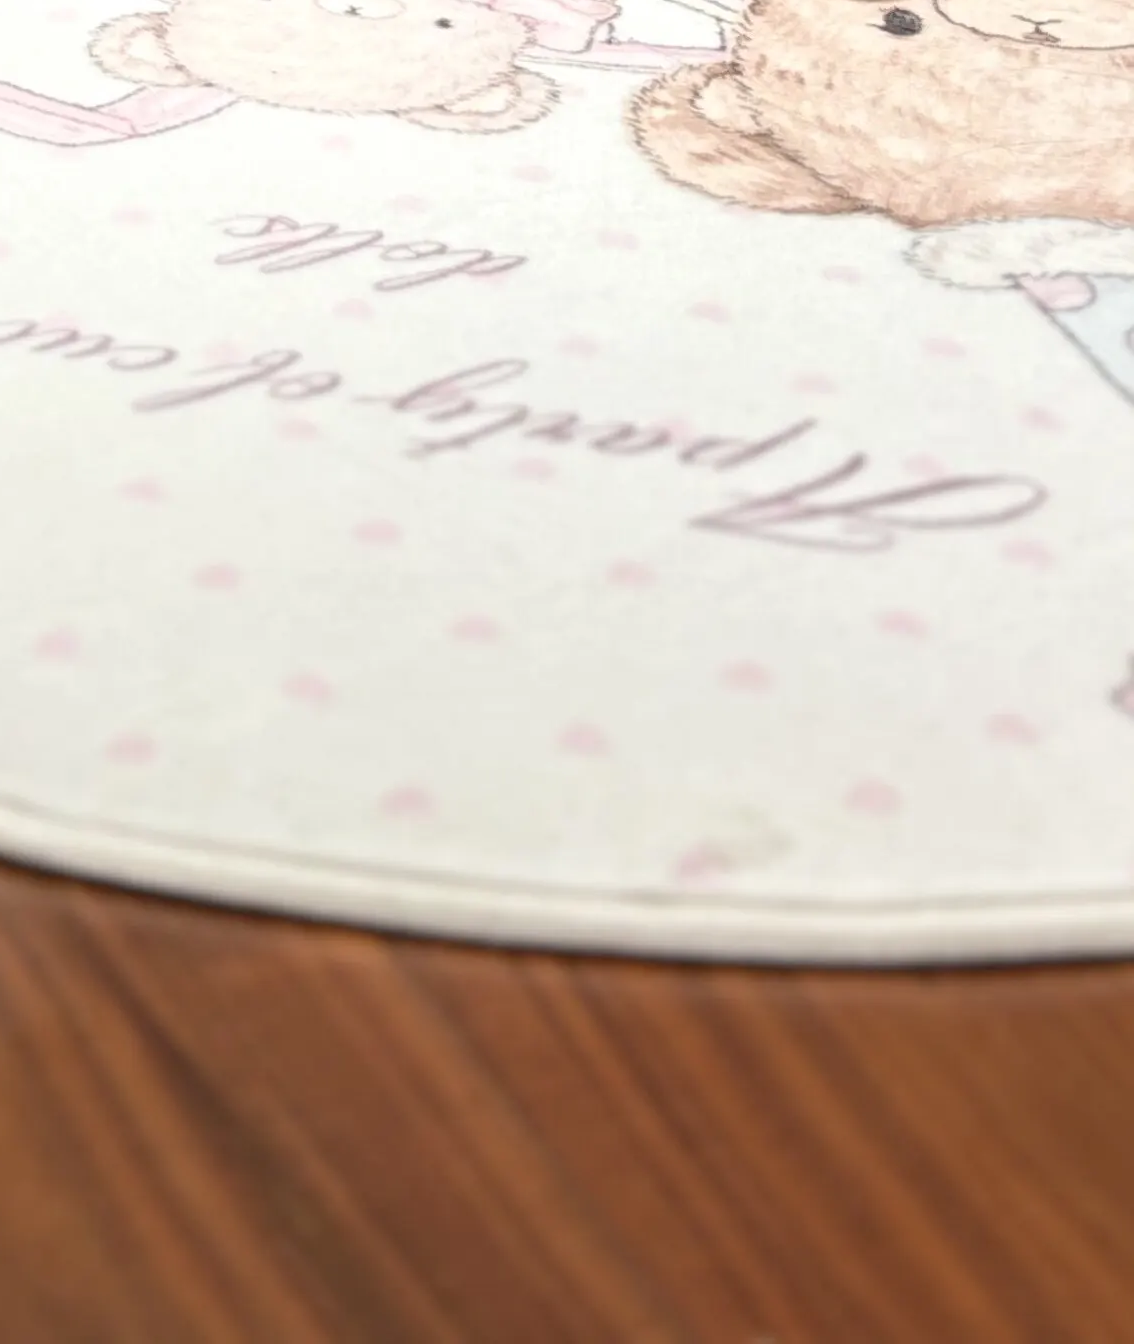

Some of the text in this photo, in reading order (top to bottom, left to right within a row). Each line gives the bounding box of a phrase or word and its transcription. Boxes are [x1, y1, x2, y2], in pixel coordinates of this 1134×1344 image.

[207, 215, 528, 291] dolls
[130, 349, 342, 411] of
[352, 358, 818, 470] party
[690, 453, 1050, 554] A
